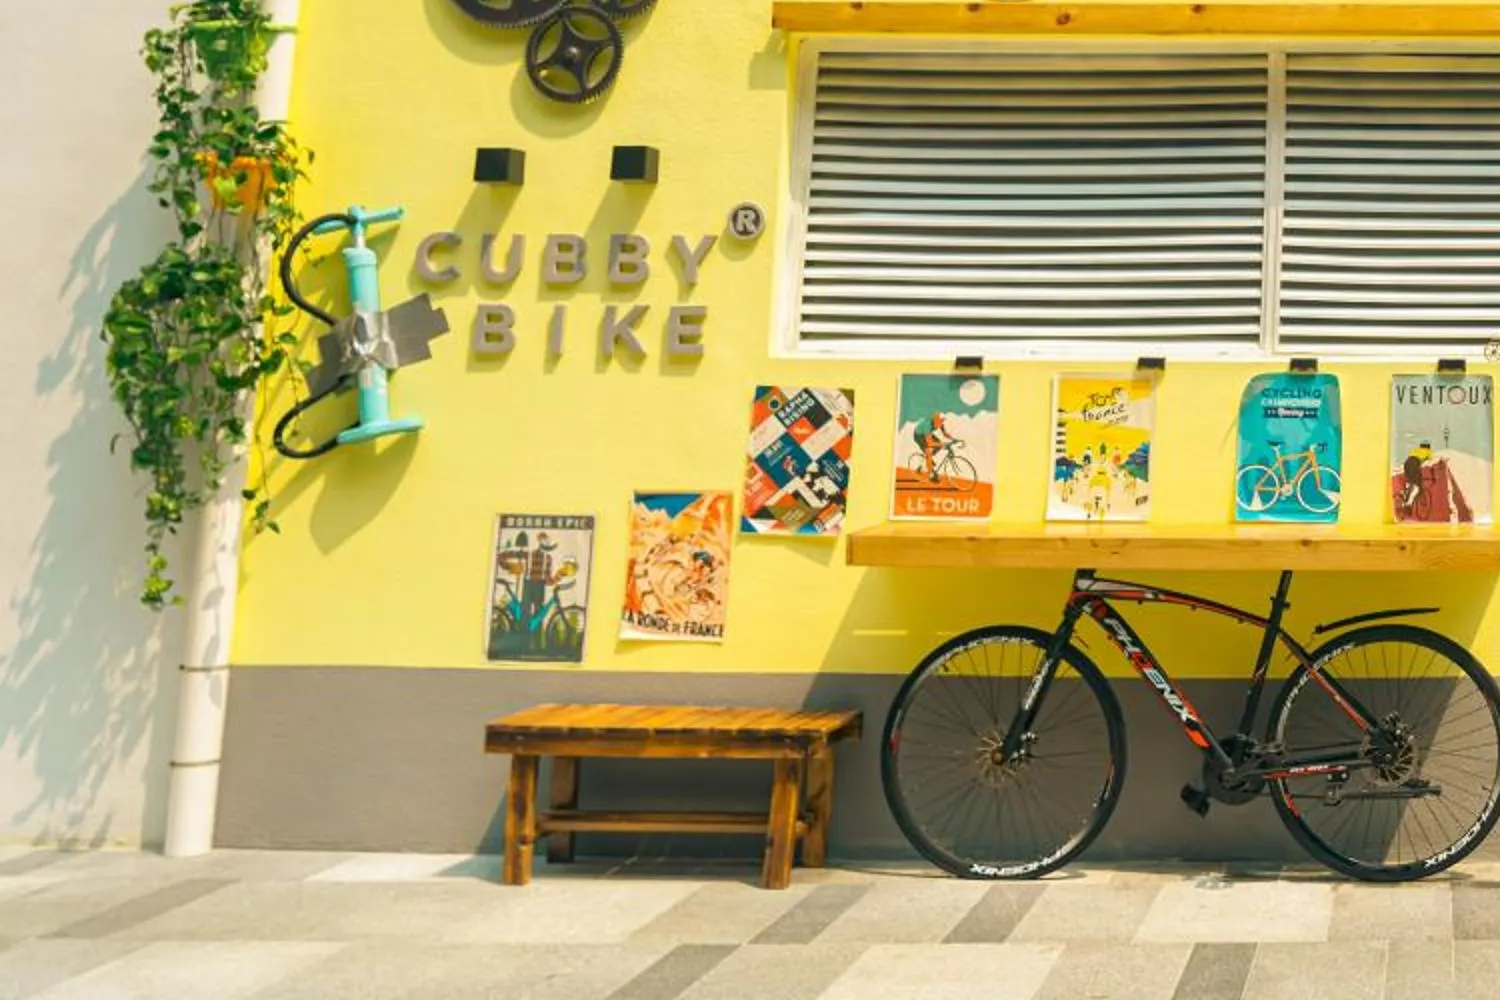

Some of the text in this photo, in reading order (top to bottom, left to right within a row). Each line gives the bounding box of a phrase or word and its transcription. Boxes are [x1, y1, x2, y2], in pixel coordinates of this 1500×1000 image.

[415, 231, 718, 287] CUBBY
[473, 304, 709, 361] BIKE
[1395, 385, 1492, 405] VENTOUX
[906, 499, 981, 514] LE TOUR
[683, 621, 725, 638] FRANCE
